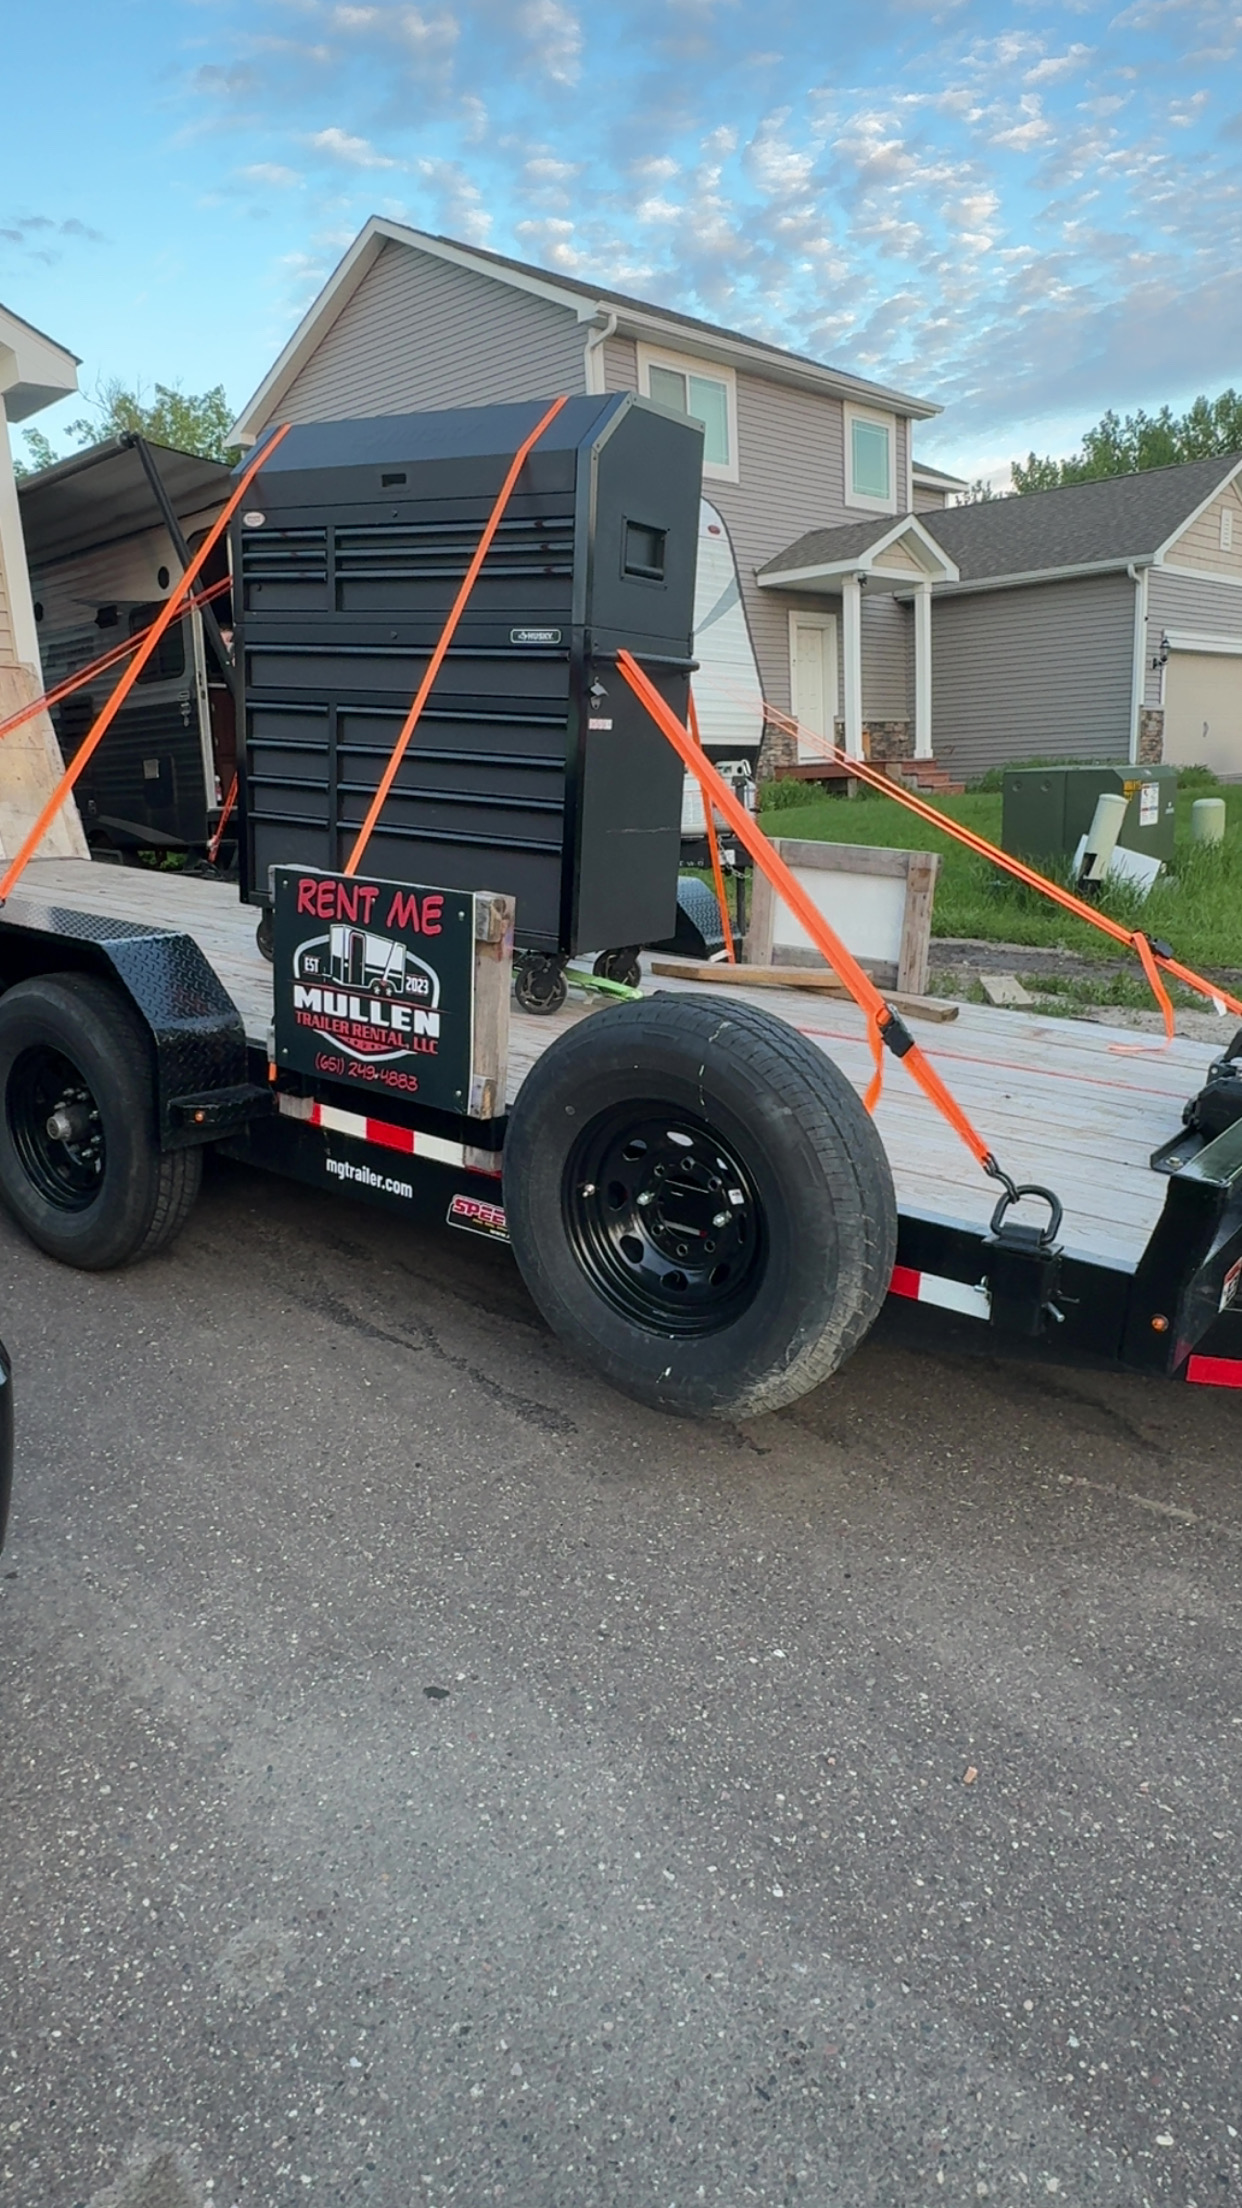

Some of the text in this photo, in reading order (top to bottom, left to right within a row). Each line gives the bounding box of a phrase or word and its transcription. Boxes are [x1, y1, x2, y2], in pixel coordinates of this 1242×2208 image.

[297, 878, 445, 936] RENT ME
[304, 956, 321, 974] EST
[405, 976, 429, 995] 2023
[293, 985, 440, 1039] MULLEN
[294, 1010, 439, 1055] TRAILER RENTAL, LLC
[315, 1051, 346, 1076] (651)
[325, 1157, 413, 1199] mgtrailer.com
